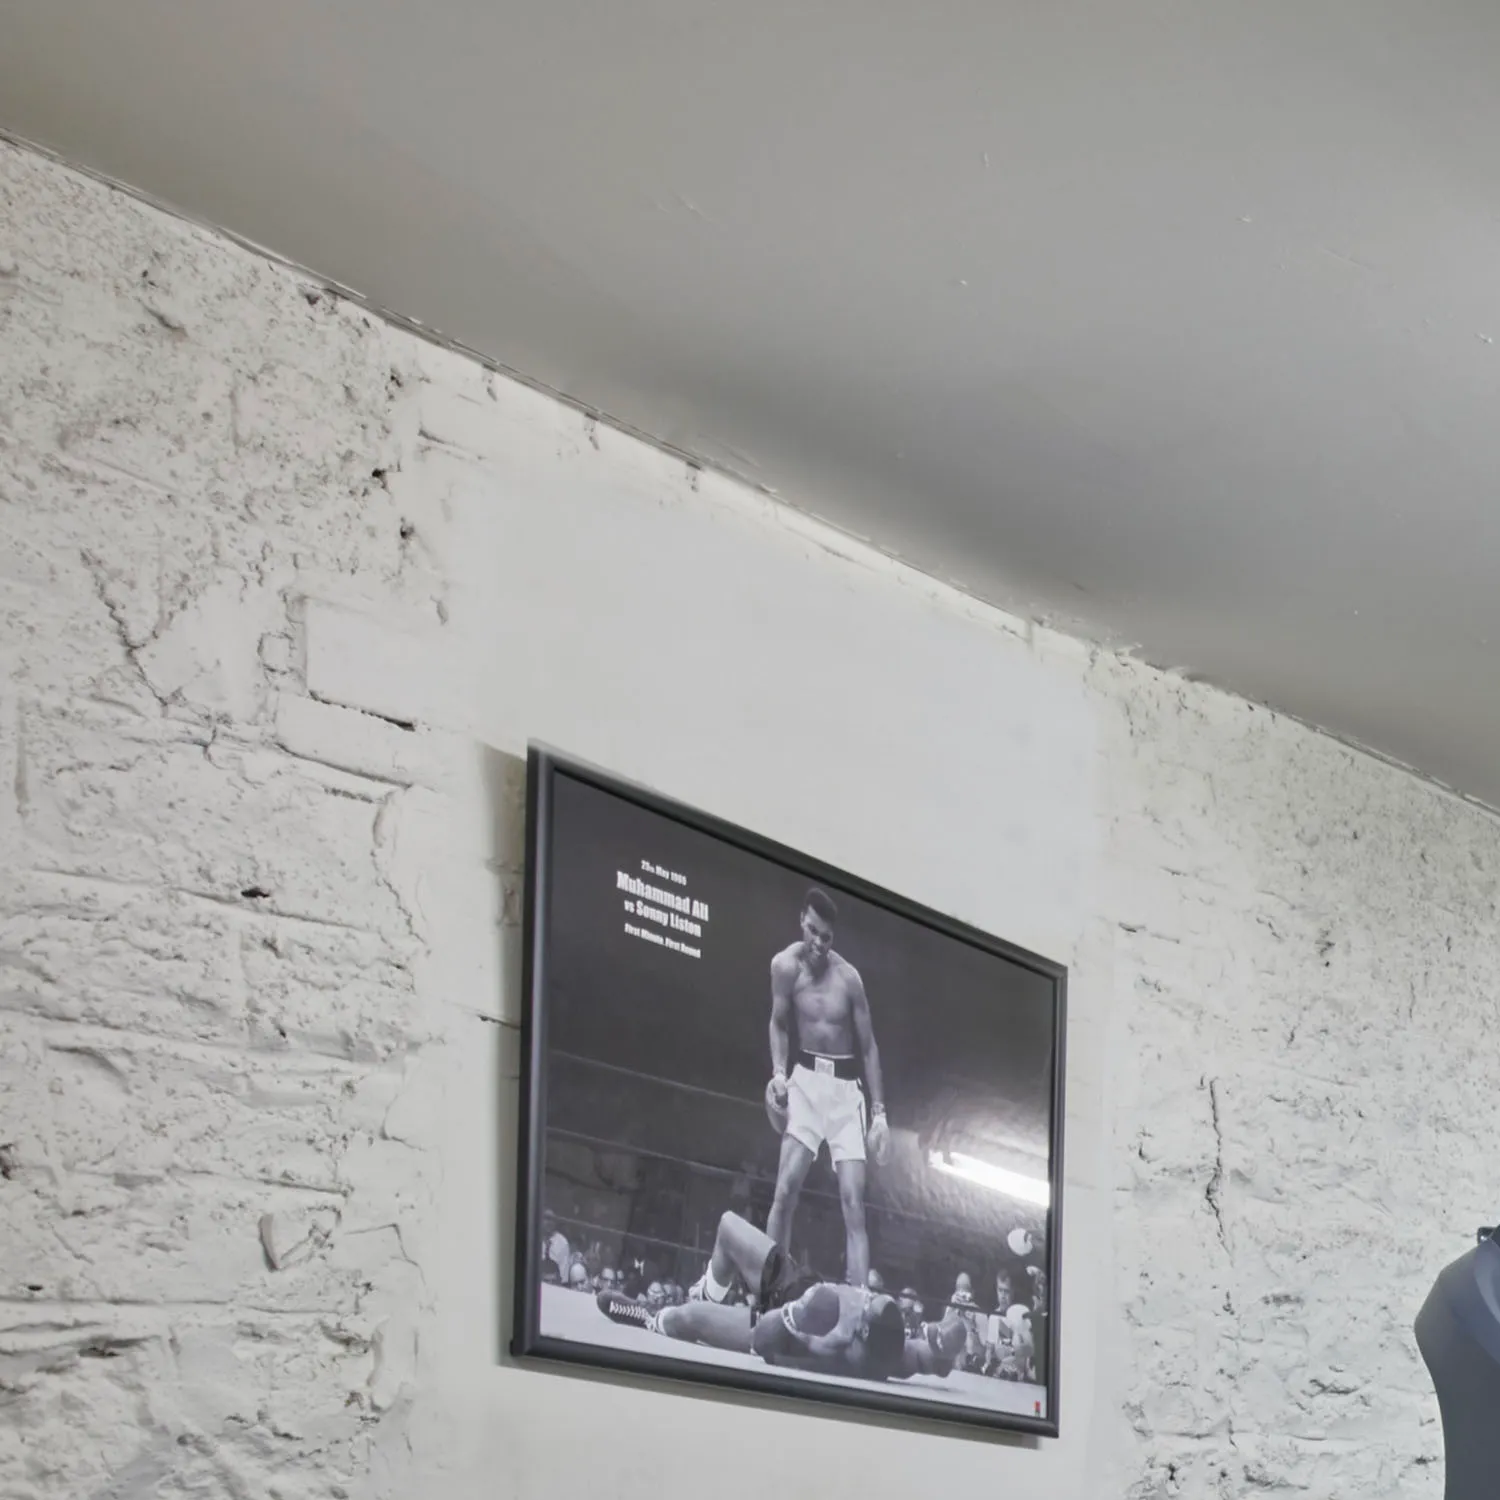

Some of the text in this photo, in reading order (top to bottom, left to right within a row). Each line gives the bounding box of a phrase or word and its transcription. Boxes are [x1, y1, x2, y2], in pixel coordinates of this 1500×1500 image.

[616, 870, 691, 915] Muhammad
[636, 900, 669, 927] Sonny
[669, 912, 702, 937] Liston
